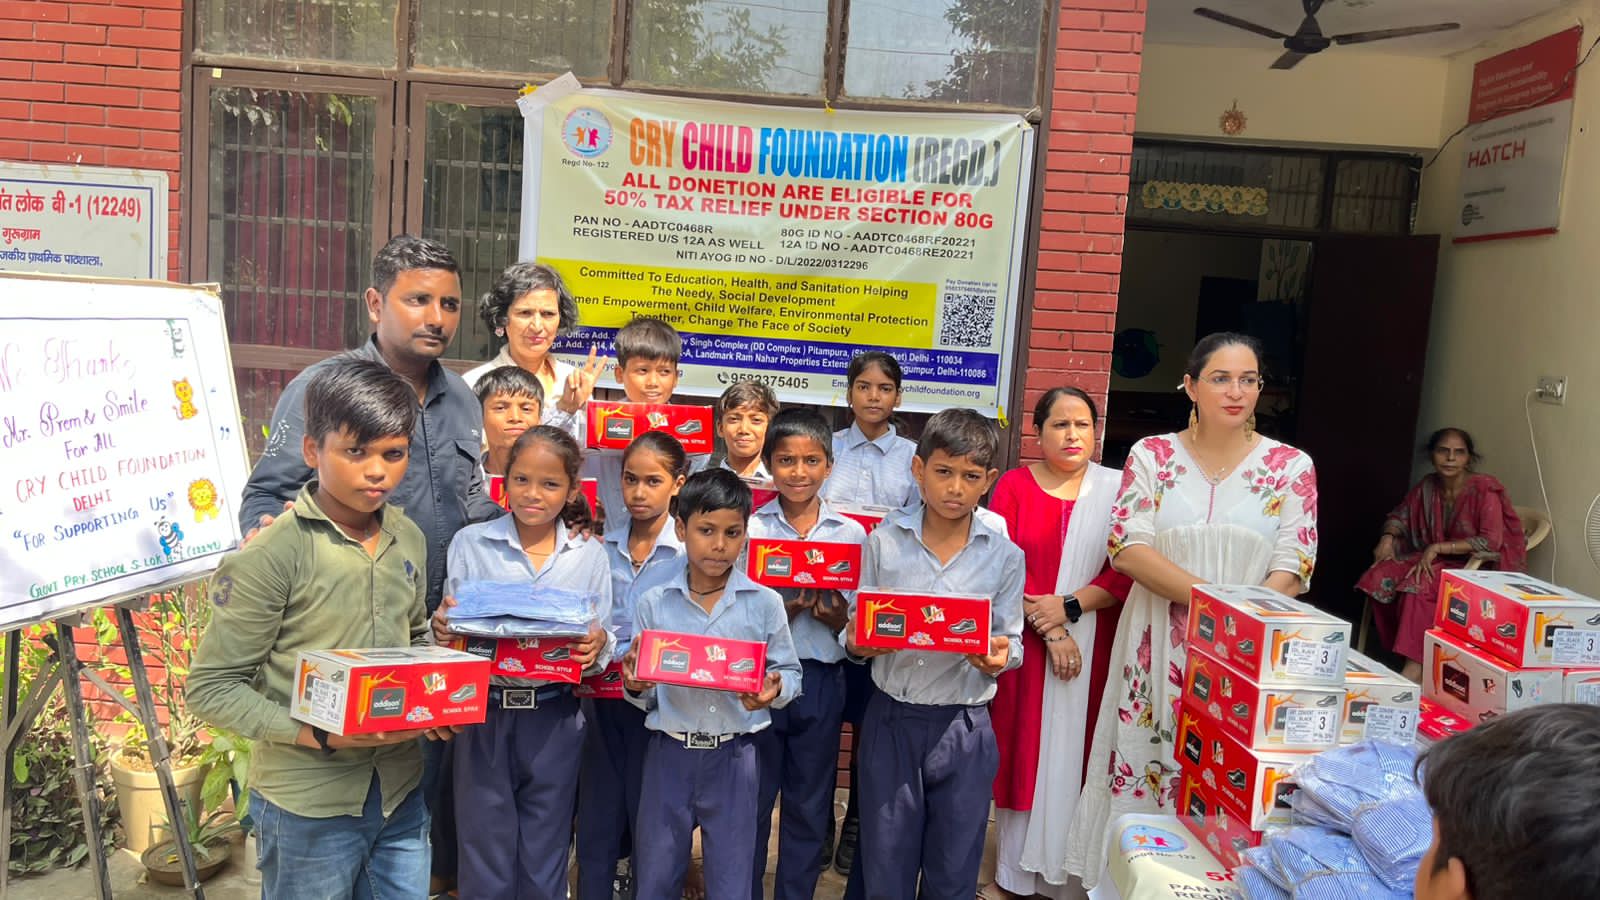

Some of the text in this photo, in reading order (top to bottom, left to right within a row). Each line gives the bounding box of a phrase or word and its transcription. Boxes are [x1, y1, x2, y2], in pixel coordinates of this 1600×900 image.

[630, 118, 677, 168] CRY
[682, 121, 753, 174] CHILD
[758, 128, 909, 183] FOUNDATION
[1467, 140, 1527, 169] HATCH
[562, 158, 582, 168] Regd
[597, 161, 610, 169] 122
[622, 172, 973, 208] ALL DONETION ARE ELIGIBLE FOR
[16, 189, 45, 212] लोक
[51, 190, 66, 214] बी
[88, 195, 141, 222] (12249)
[604, 190, 993, 229] 50% TAX RELIEF UNDER SECTION 80G
[573, 215, 599, 226] PAN
[602, 218, 621, 228] NO
[631, 220, 713, 234] AADTC0468R
[780, 229, 804, 239] 80G
[808, 229, 820, 239] ID
[824, 230, 843, 240] NO
[573, 227, 765, 250] REGISTERED U/S 12A AS WELL
[780, 240, 801, 250] 12A
[805, 241, 817, 251] ID
[821, 242, 840, 252] NO
[676, 250, 697, 260] NITI
[700, 252, 732, 263] AYOG
[735, 254, 746, 263] ID
[749, 255, 766, 264] NO
[776, 256, 869, 270] D/L/2022/0312296
[580, 266, 909, 300] Committed To Education, Health, and Sanitation Helping
[651, 285, 836, 308] The Needy, Social Development
[575, 296, 929, 327] men Empowerment, Child Welfare, Environmental Protection
[688, 314, 733, 329] Change
[737, 318, 758, 329] The
[761, 319, 790, 331] Face
[793, 323, 806, 332] of
[808, 323, 852, 337] Society
[552, 340, 563, 349] gd.
[566, 340, 585, 349] Add.
[695, 350, 734, 361] Landmark
[735, 352, 753, 362] Ram
[755, 353, 778, 364] Nahar
[780, 356, 820, 367] Properties
[822, 359, 850, 369] Extens
[592, 332, 610, 340] Add.
[690, 337, 713, 349] Singh
[714, 339, 749, 352] Complex
[750, 341, 765, 352] (DD
[766, 343, 801, 355] Complex
[808, 346, 850, 360] Pitampura,
[910, 354, 930, 364] Delhi
[832, 379, 850, 388] Ema
[900, 385, 981, 399] ychildfoundation.org
[40, 401, 81, 437] Prem
[103, 388, 148, 422] Smile
[64, 440, 88, 460] For
[16, 449, 206, 503] CRY CHILD FOUNDATION
[72, 489, 113, 512] DELHI
[91, 563, 127, 583] SCHOOL
[144, 554, 163, 566] LOK
[213, 575, 233, 608] 3
[1587, 638, 1594, 652] 3
[1321, 650, 1329, 664] 3
[1319, 716, 1326, 730] 3
[1399, 716, 1407, 729] 3
[1169, 883, 1210, 892] PAN
